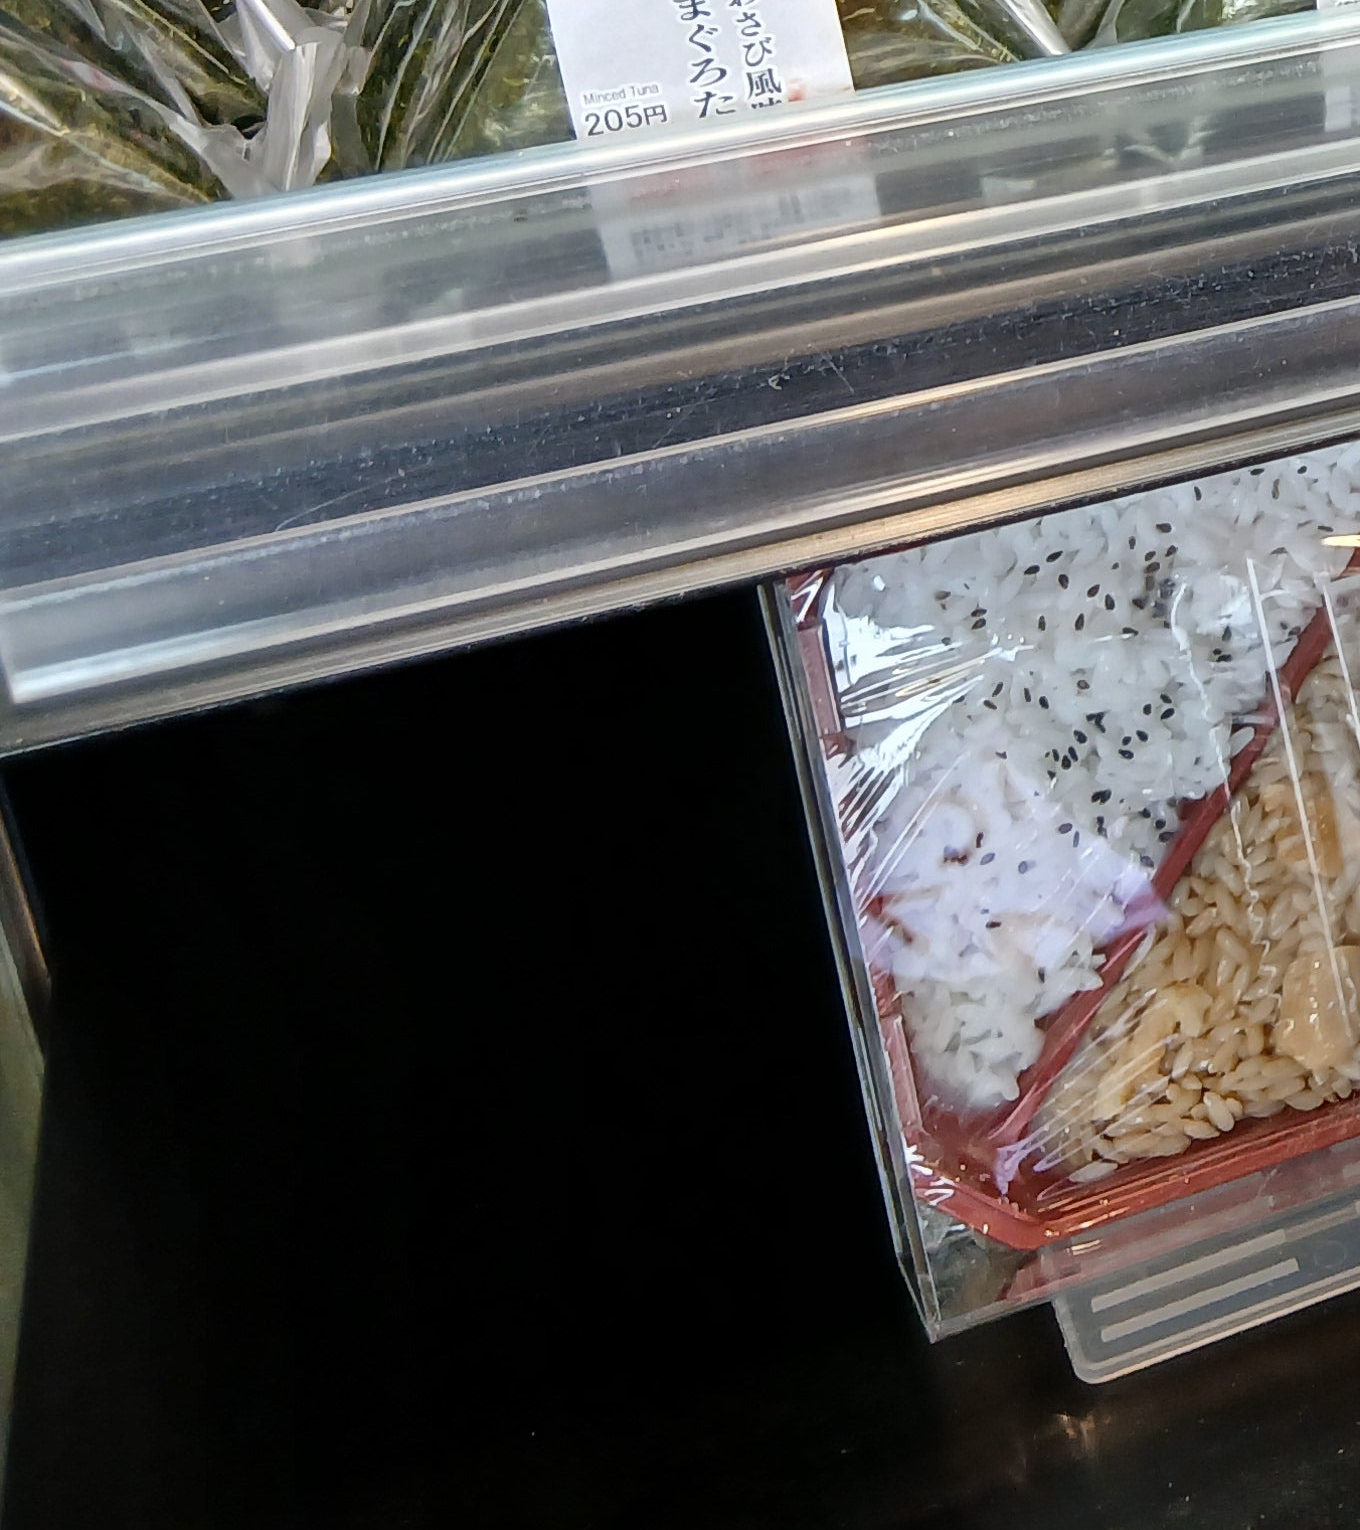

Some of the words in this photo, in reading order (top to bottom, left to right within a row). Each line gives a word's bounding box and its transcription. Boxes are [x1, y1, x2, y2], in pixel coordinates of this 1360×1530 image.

[583, 89, 627, 106] Minced
[631, 83, 660, 99] Tuna
[585, 103, 668, 137] 205円
